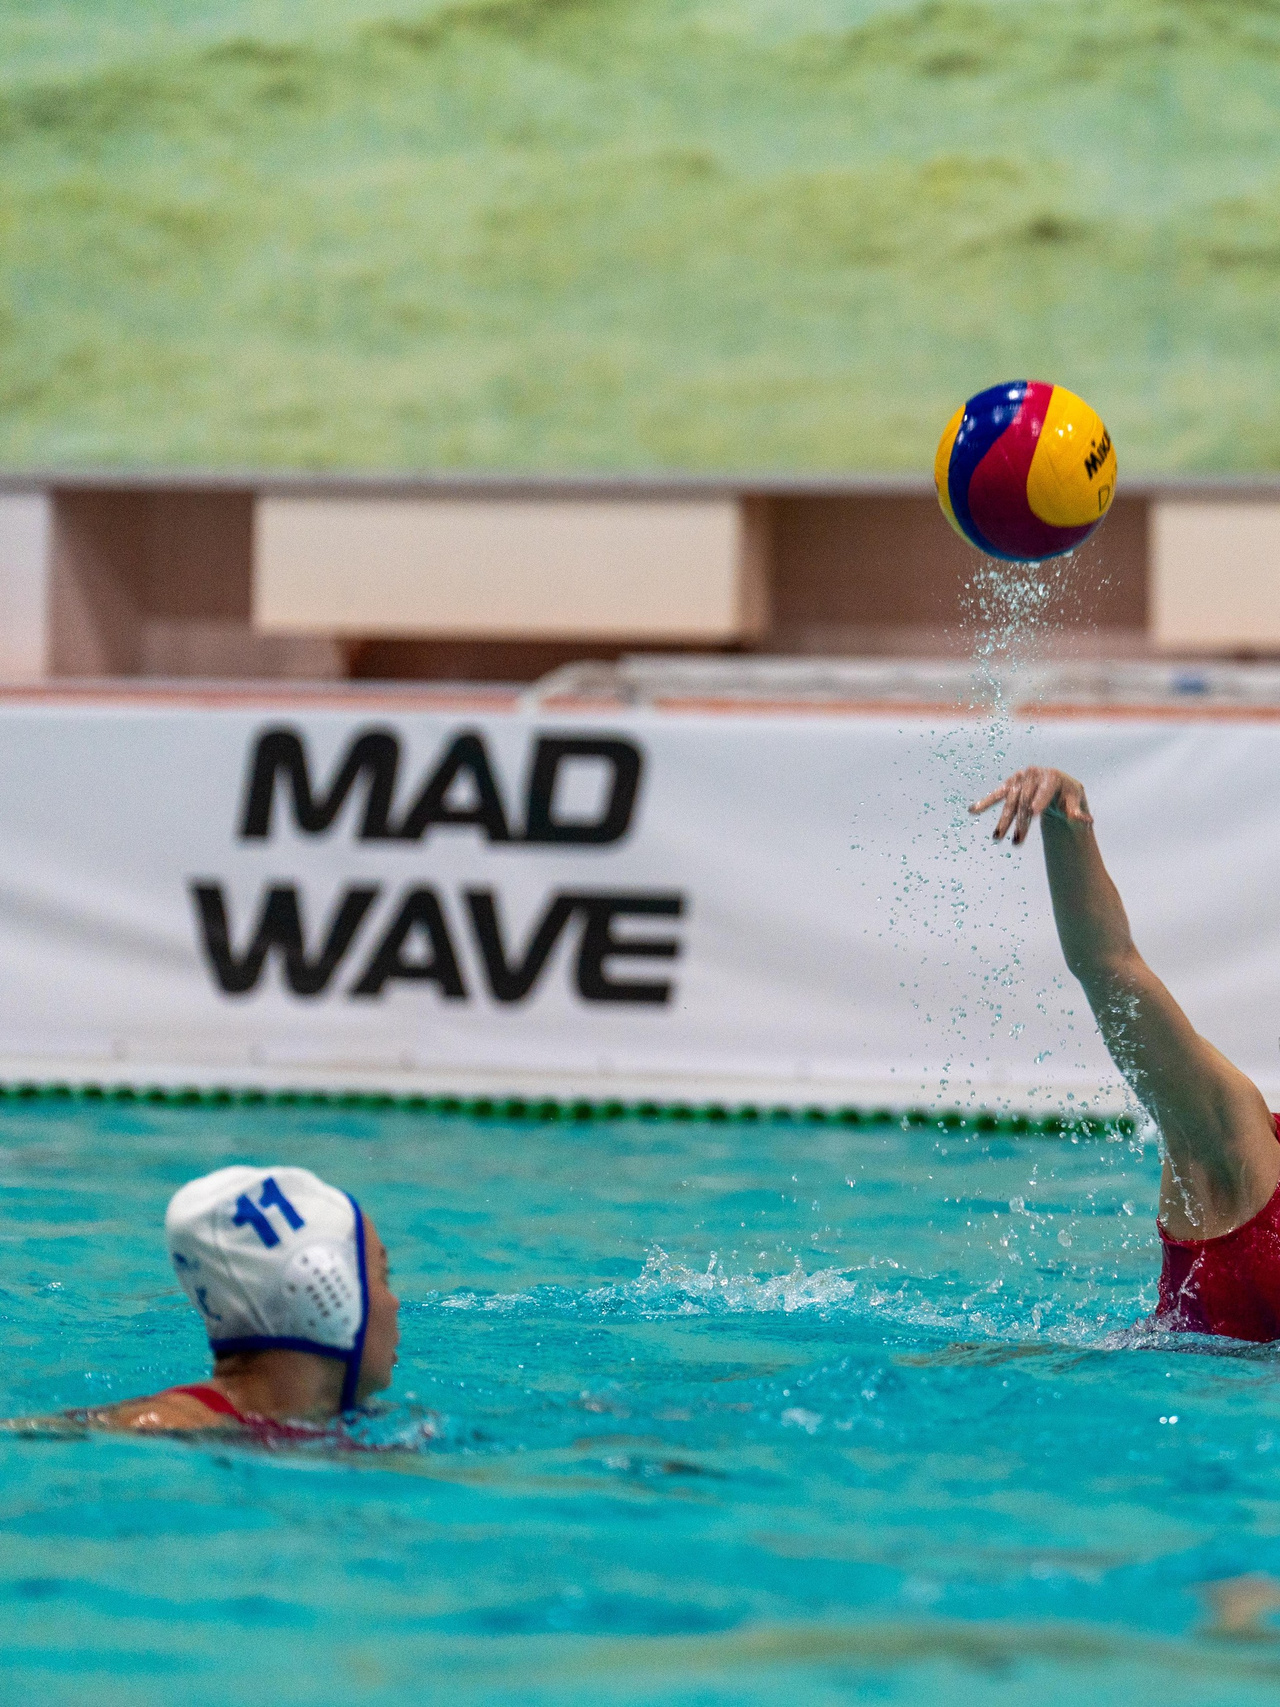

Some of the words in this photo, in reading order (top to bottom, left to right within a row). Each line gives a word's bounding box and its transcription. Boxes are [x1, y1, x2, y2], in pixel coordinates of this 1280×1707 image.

[237, 723, 646, 850] MAD
[190, 879, 687, 1007] WAVE
[232, 1177, 305, 1249] 11
